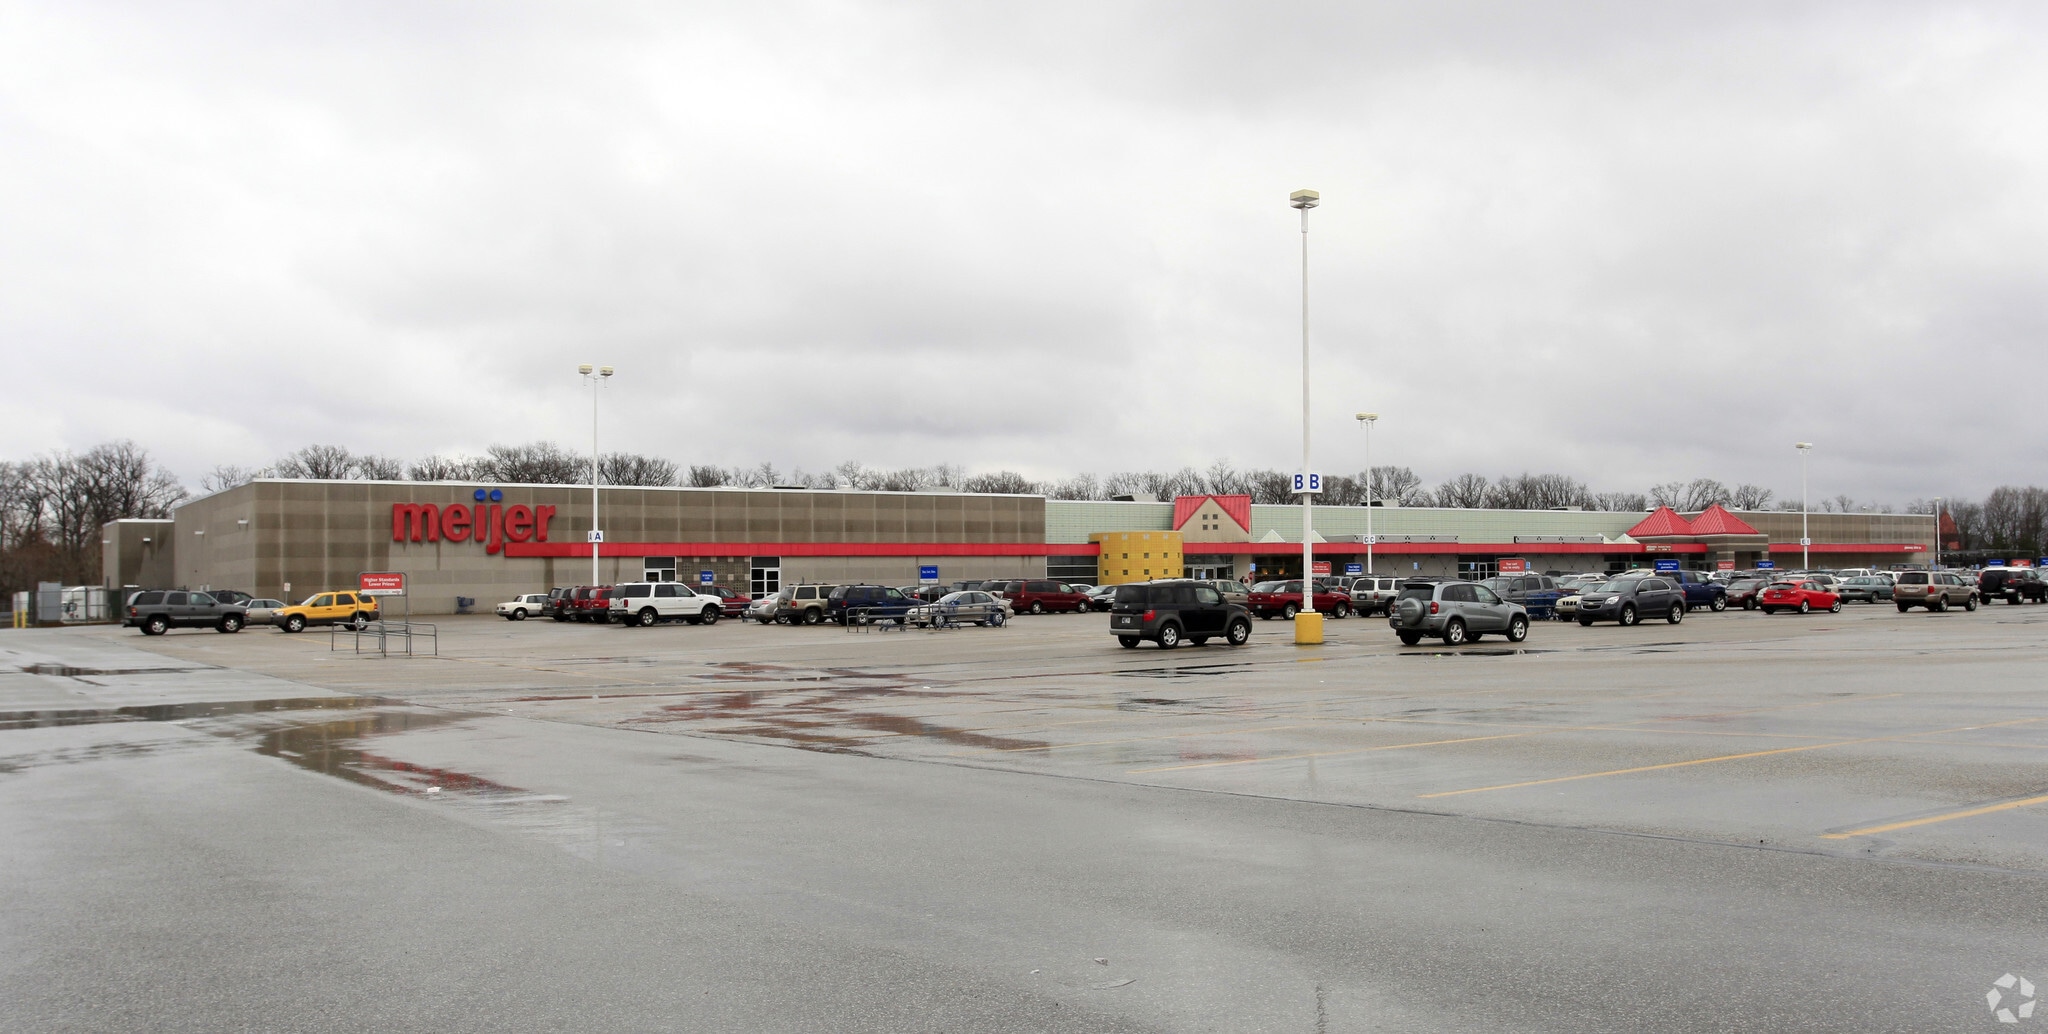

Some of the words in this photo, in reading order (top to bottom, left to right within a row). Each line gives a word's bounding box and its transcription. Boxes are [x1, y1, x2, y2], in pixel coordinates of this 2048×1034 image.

[1295, 474, 1303, 490] B
[1310, 474, 1319, 489] B
[392, 488, 556, 555] meijer
[595, 532, 601, 541] A
